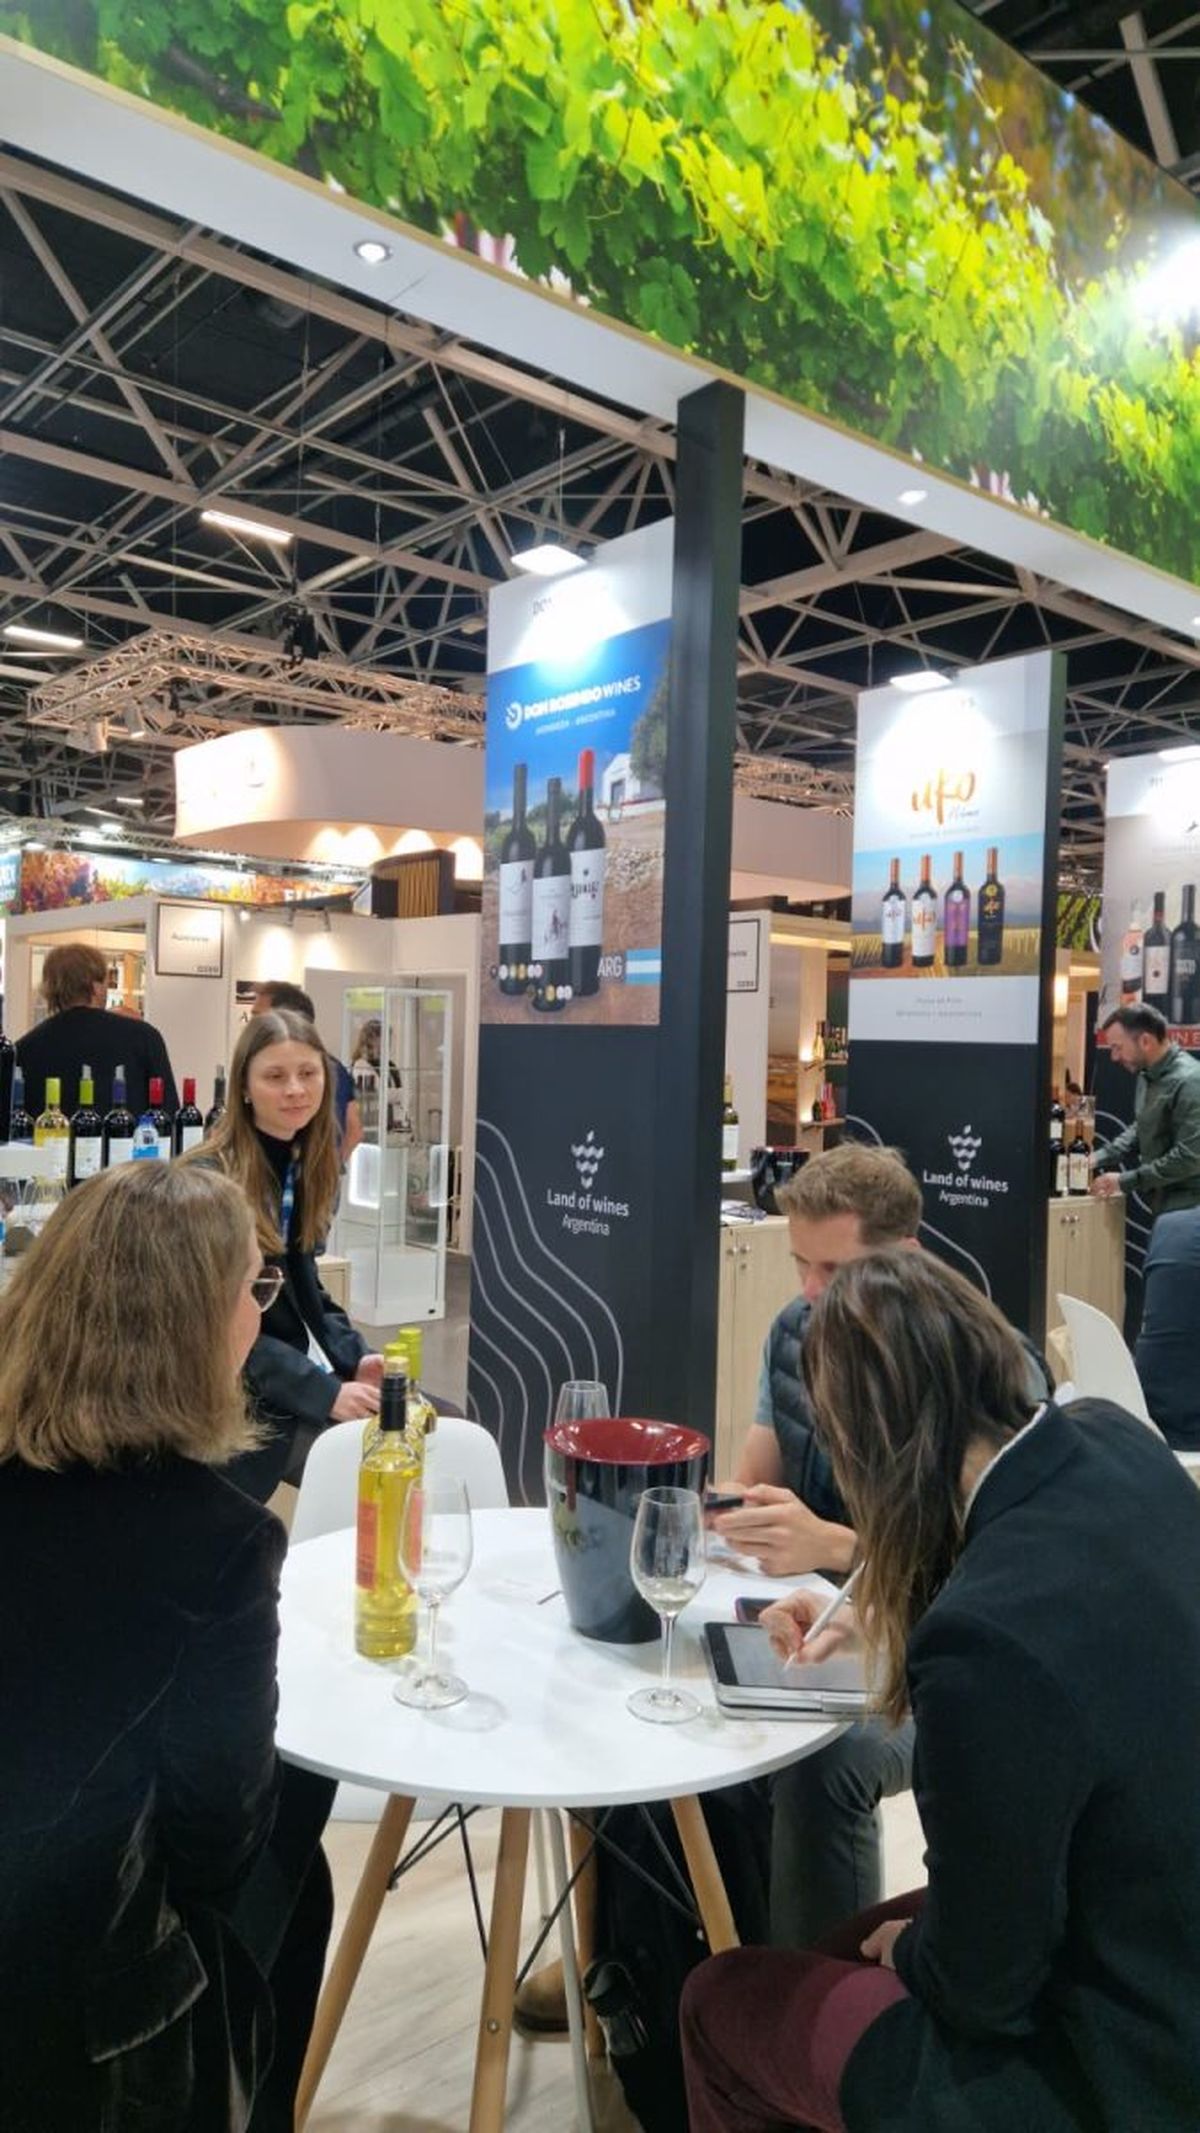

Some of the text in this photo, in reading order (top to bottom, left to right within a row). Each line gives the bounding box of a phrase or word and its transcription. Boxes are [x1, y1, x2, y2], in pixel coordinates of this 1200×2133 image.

[602, 674, 641, 698] WINES
[596, 955, 622, 977] ARG
[923, 1169, 1009, 1193] Land of wines
[546, 1188, 630, 1217] Land of wines
[939, 1189, 989, 1208] Argentina
[562, 1213, 610, 1236] Argentina
